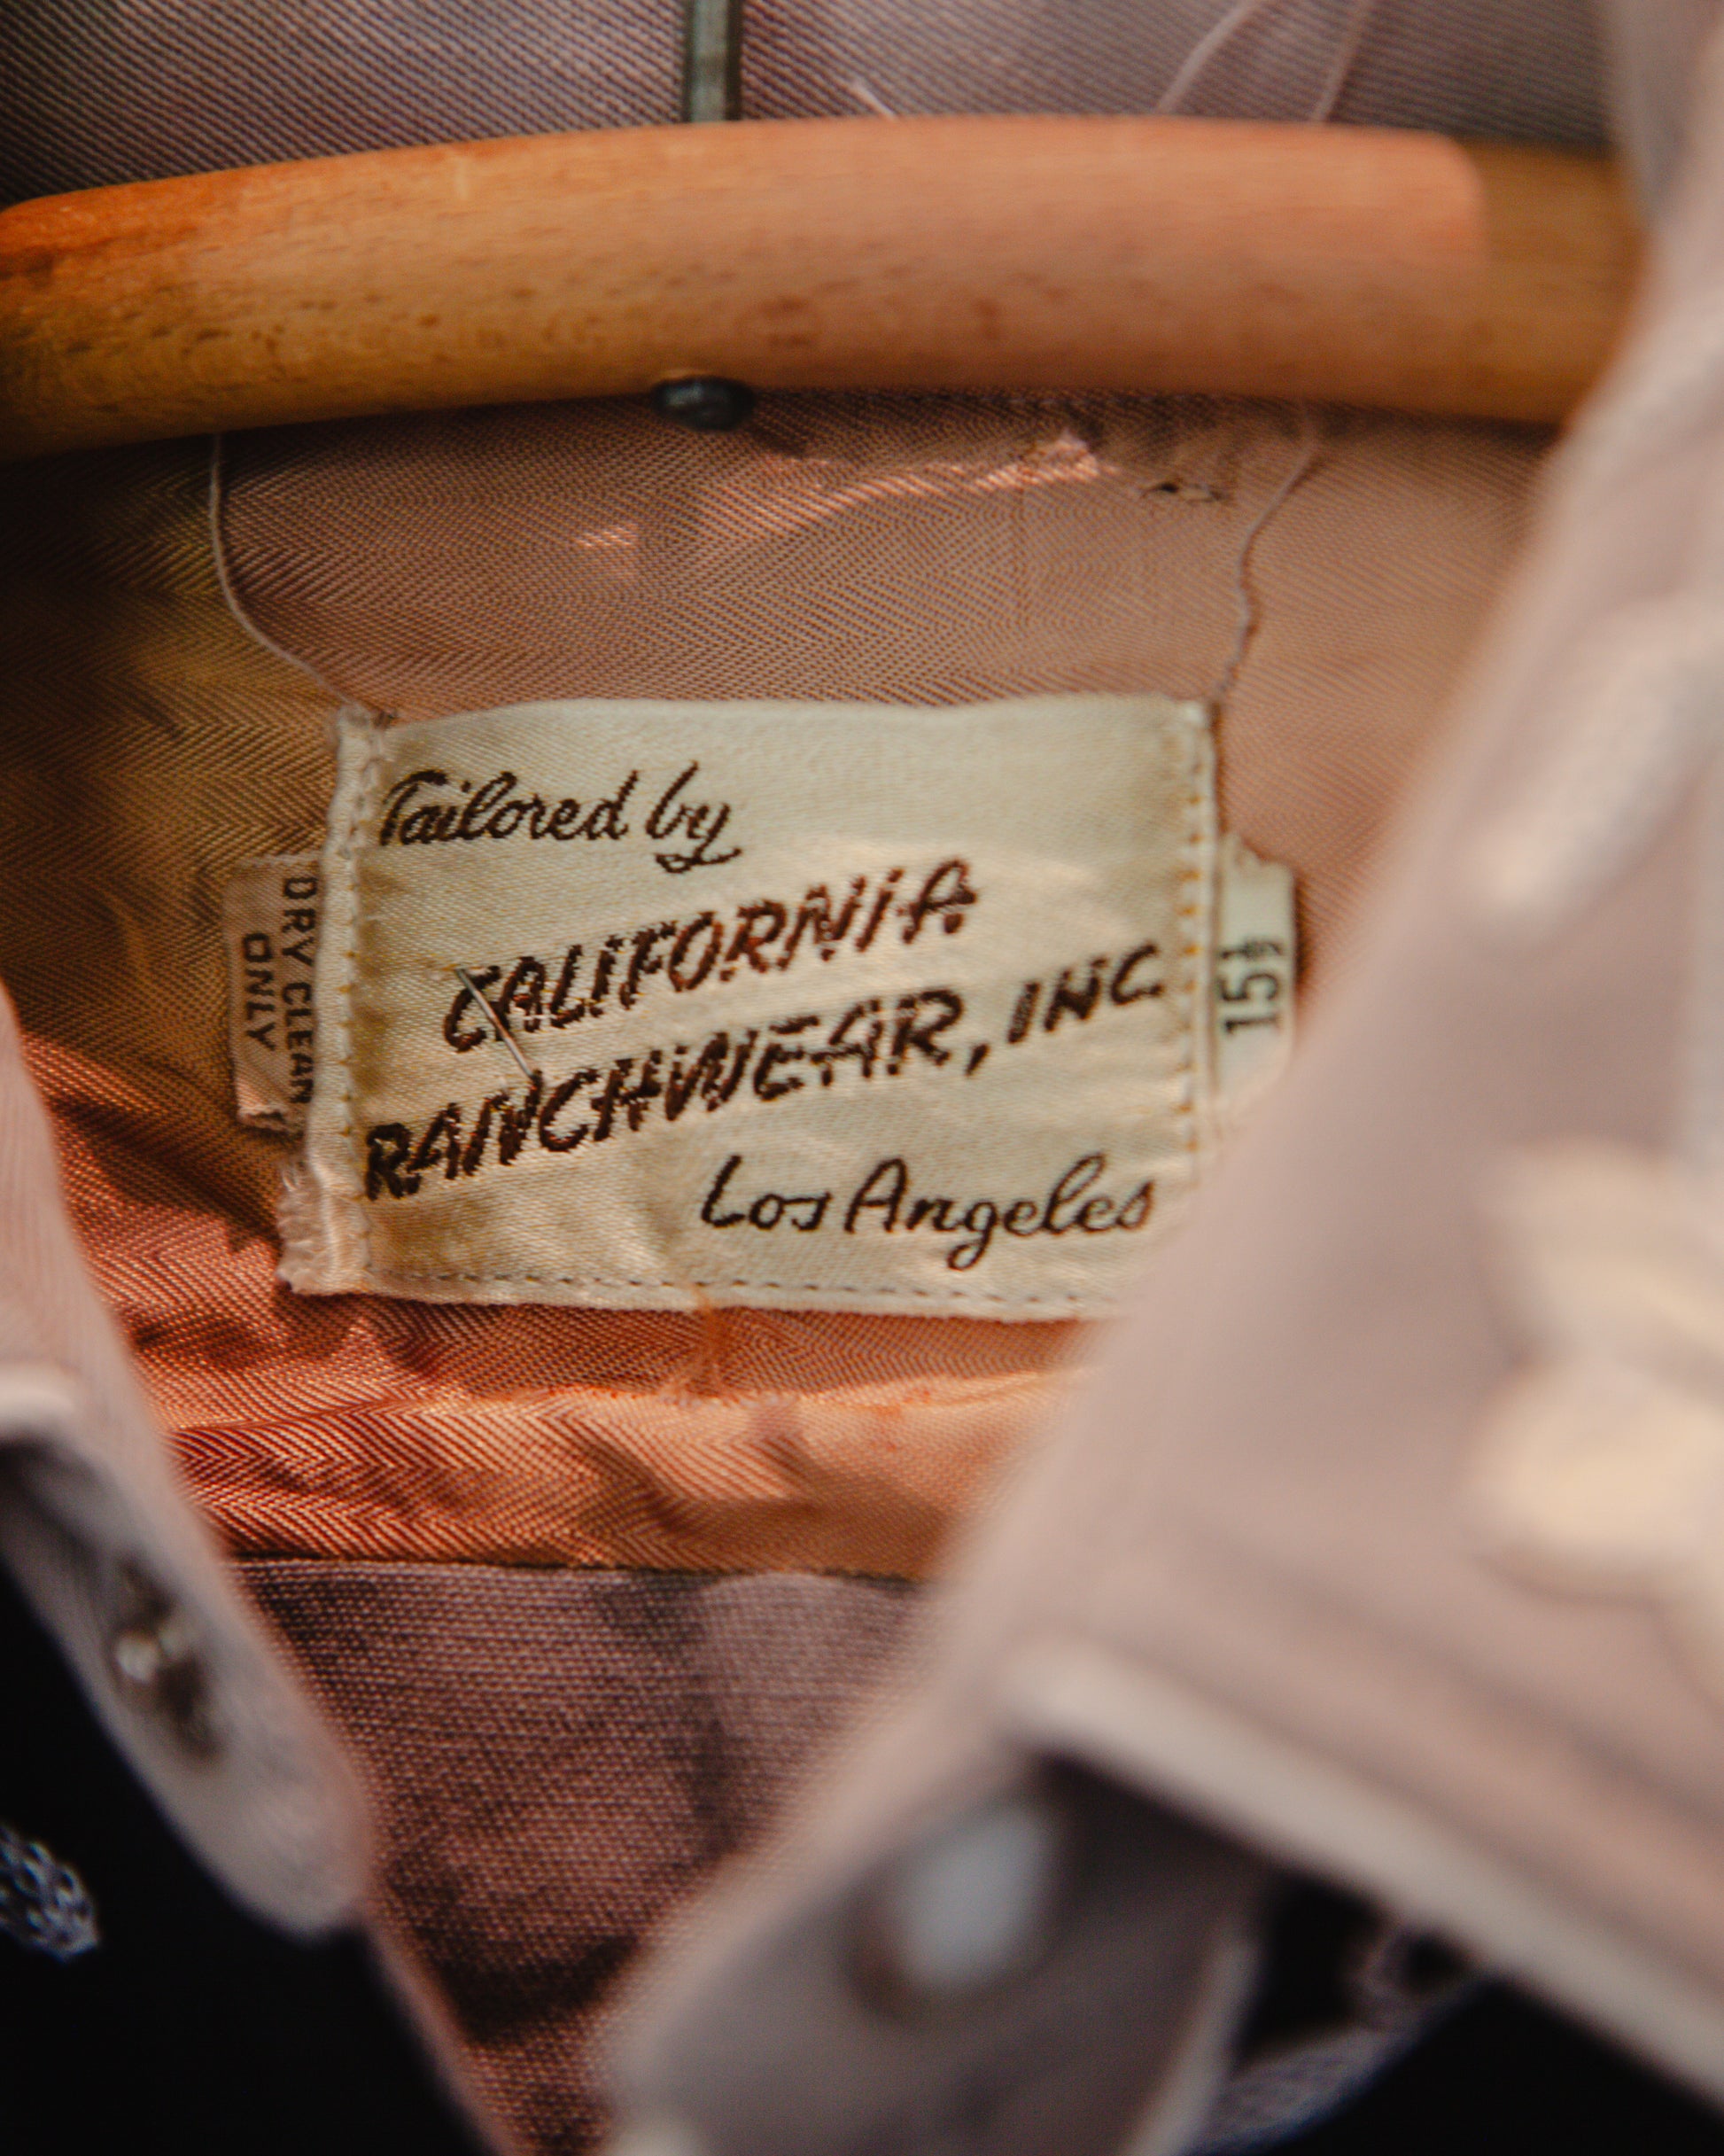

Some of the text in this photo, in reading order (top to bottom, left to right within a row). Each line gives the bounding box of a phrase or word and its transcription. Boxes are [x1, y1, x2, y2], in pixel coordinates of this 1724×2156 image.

[379, 759, 743, 875] Tailored by
[242, 932, 276, 1052] ONLY
[282, 876, 318, 1104] DRY CLEAN
[444, 858, 977, 1053] CALIFORNIA
[365, 938, 1166, 1201] RANCHWEAR, INC
[701, 1151, 1156, 1272] Los Angeles
